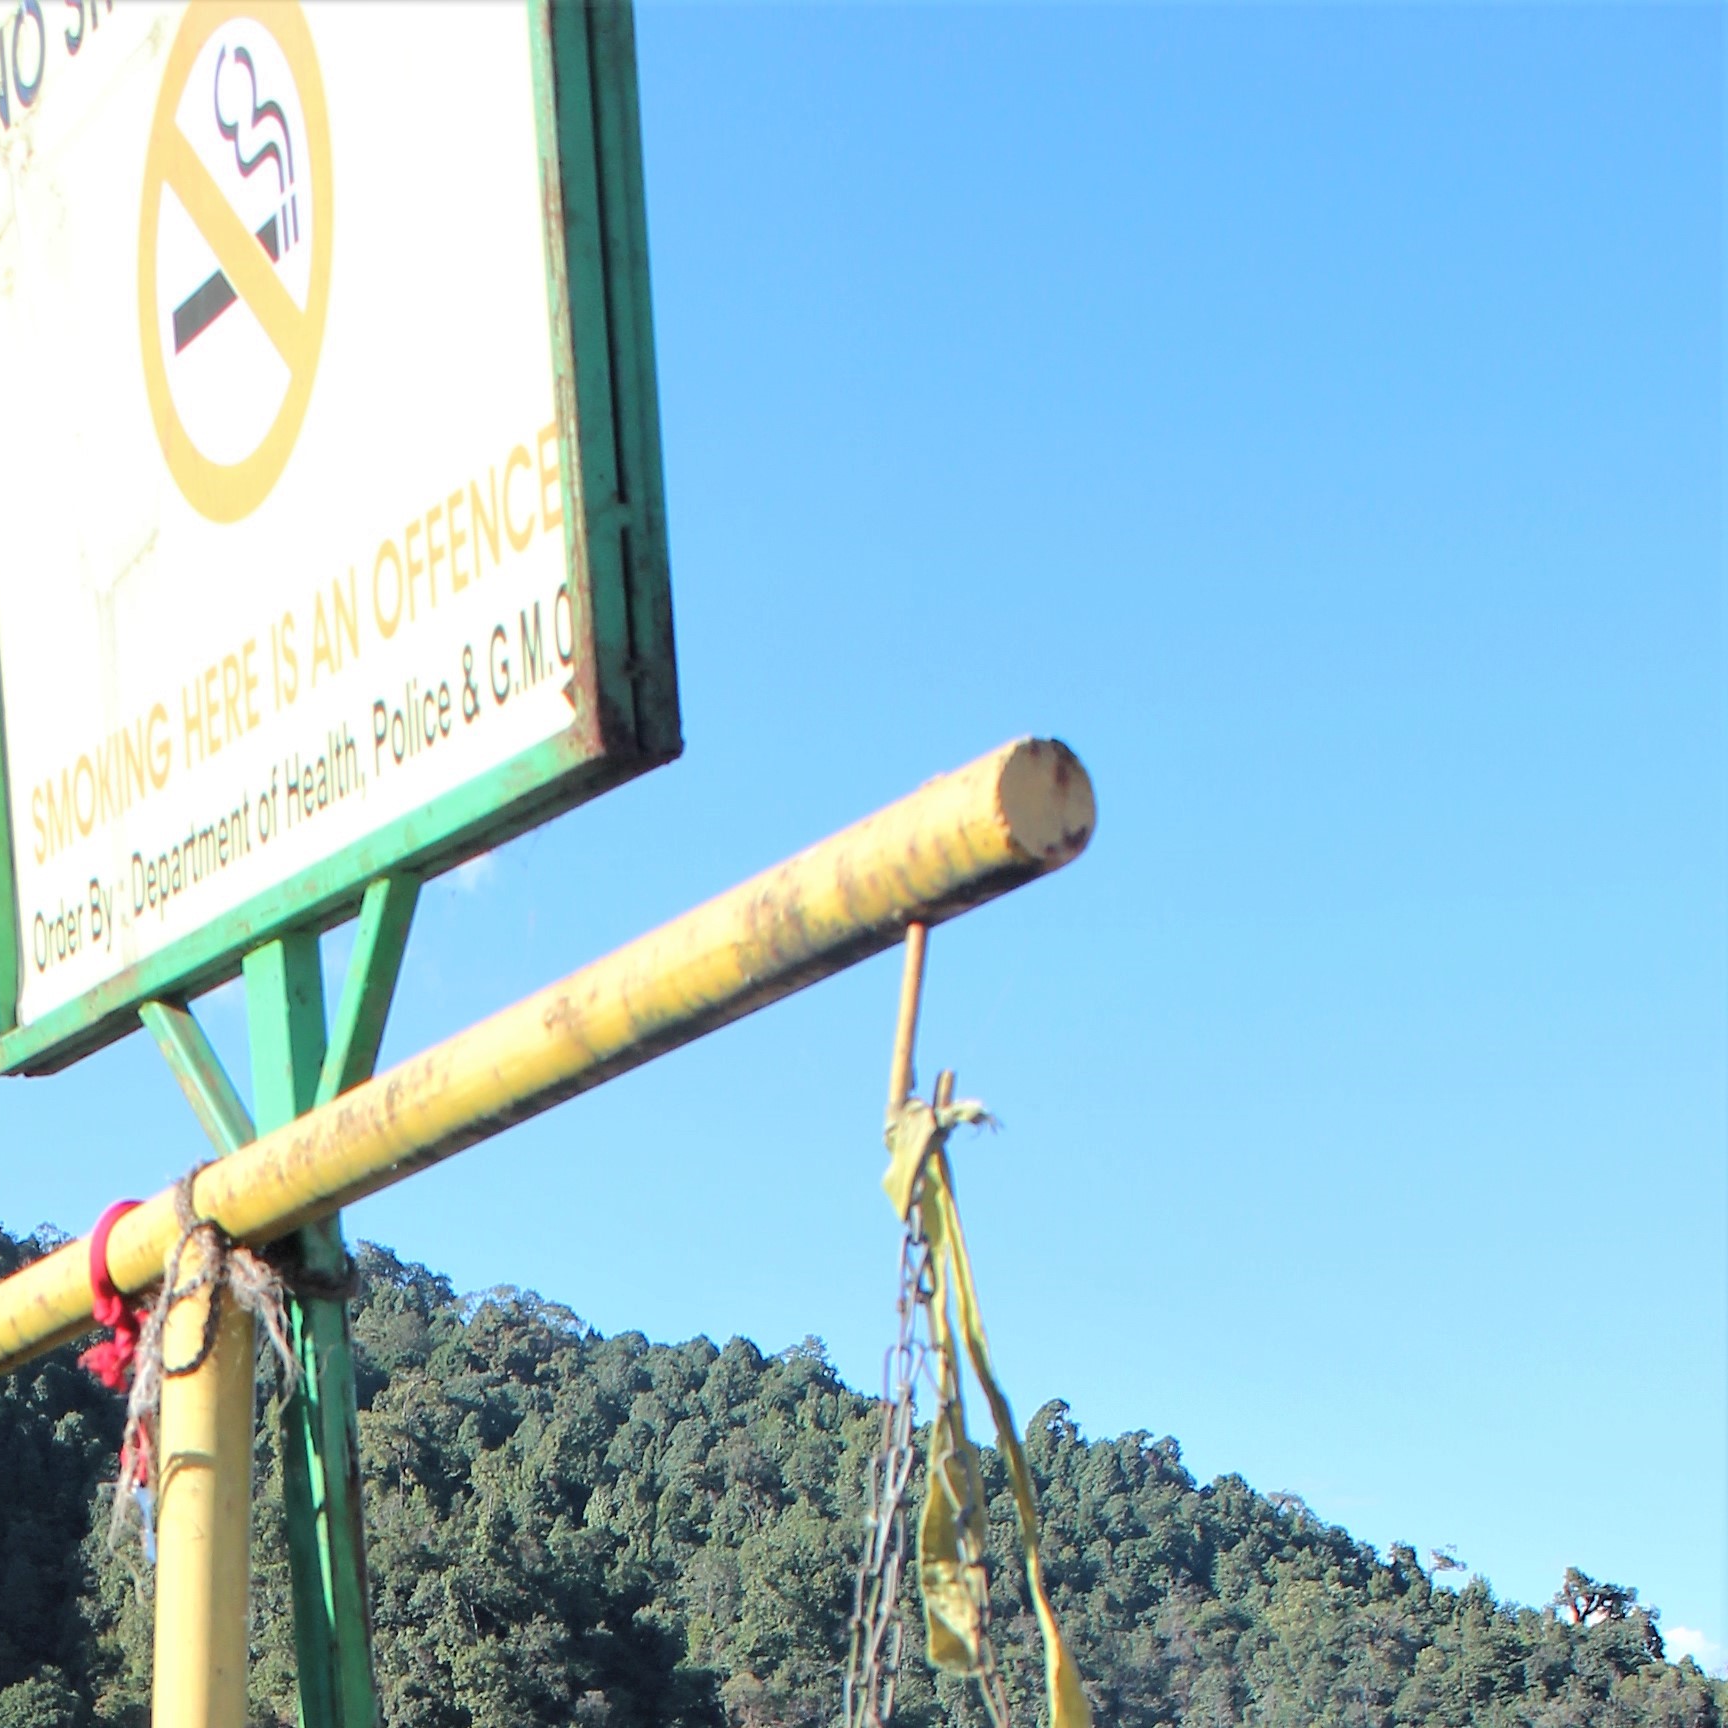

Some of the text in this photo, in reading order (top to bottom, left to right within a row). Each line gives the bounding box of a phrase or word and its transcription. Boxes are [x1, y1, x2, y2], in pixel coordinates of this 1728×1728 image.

[32, 420, 564, 865] SMOKING HERE IS AN OFFENCE
[33, 897, 83, 974] Order
[89, 876, 114, 953] By
[132, 790, 252, 922] Department
[258, 764, 277, 843] of
[285, 720, 366, 830] Health,
[373, 677, 453, 778] Police
[462, 643, 481, 725] &
